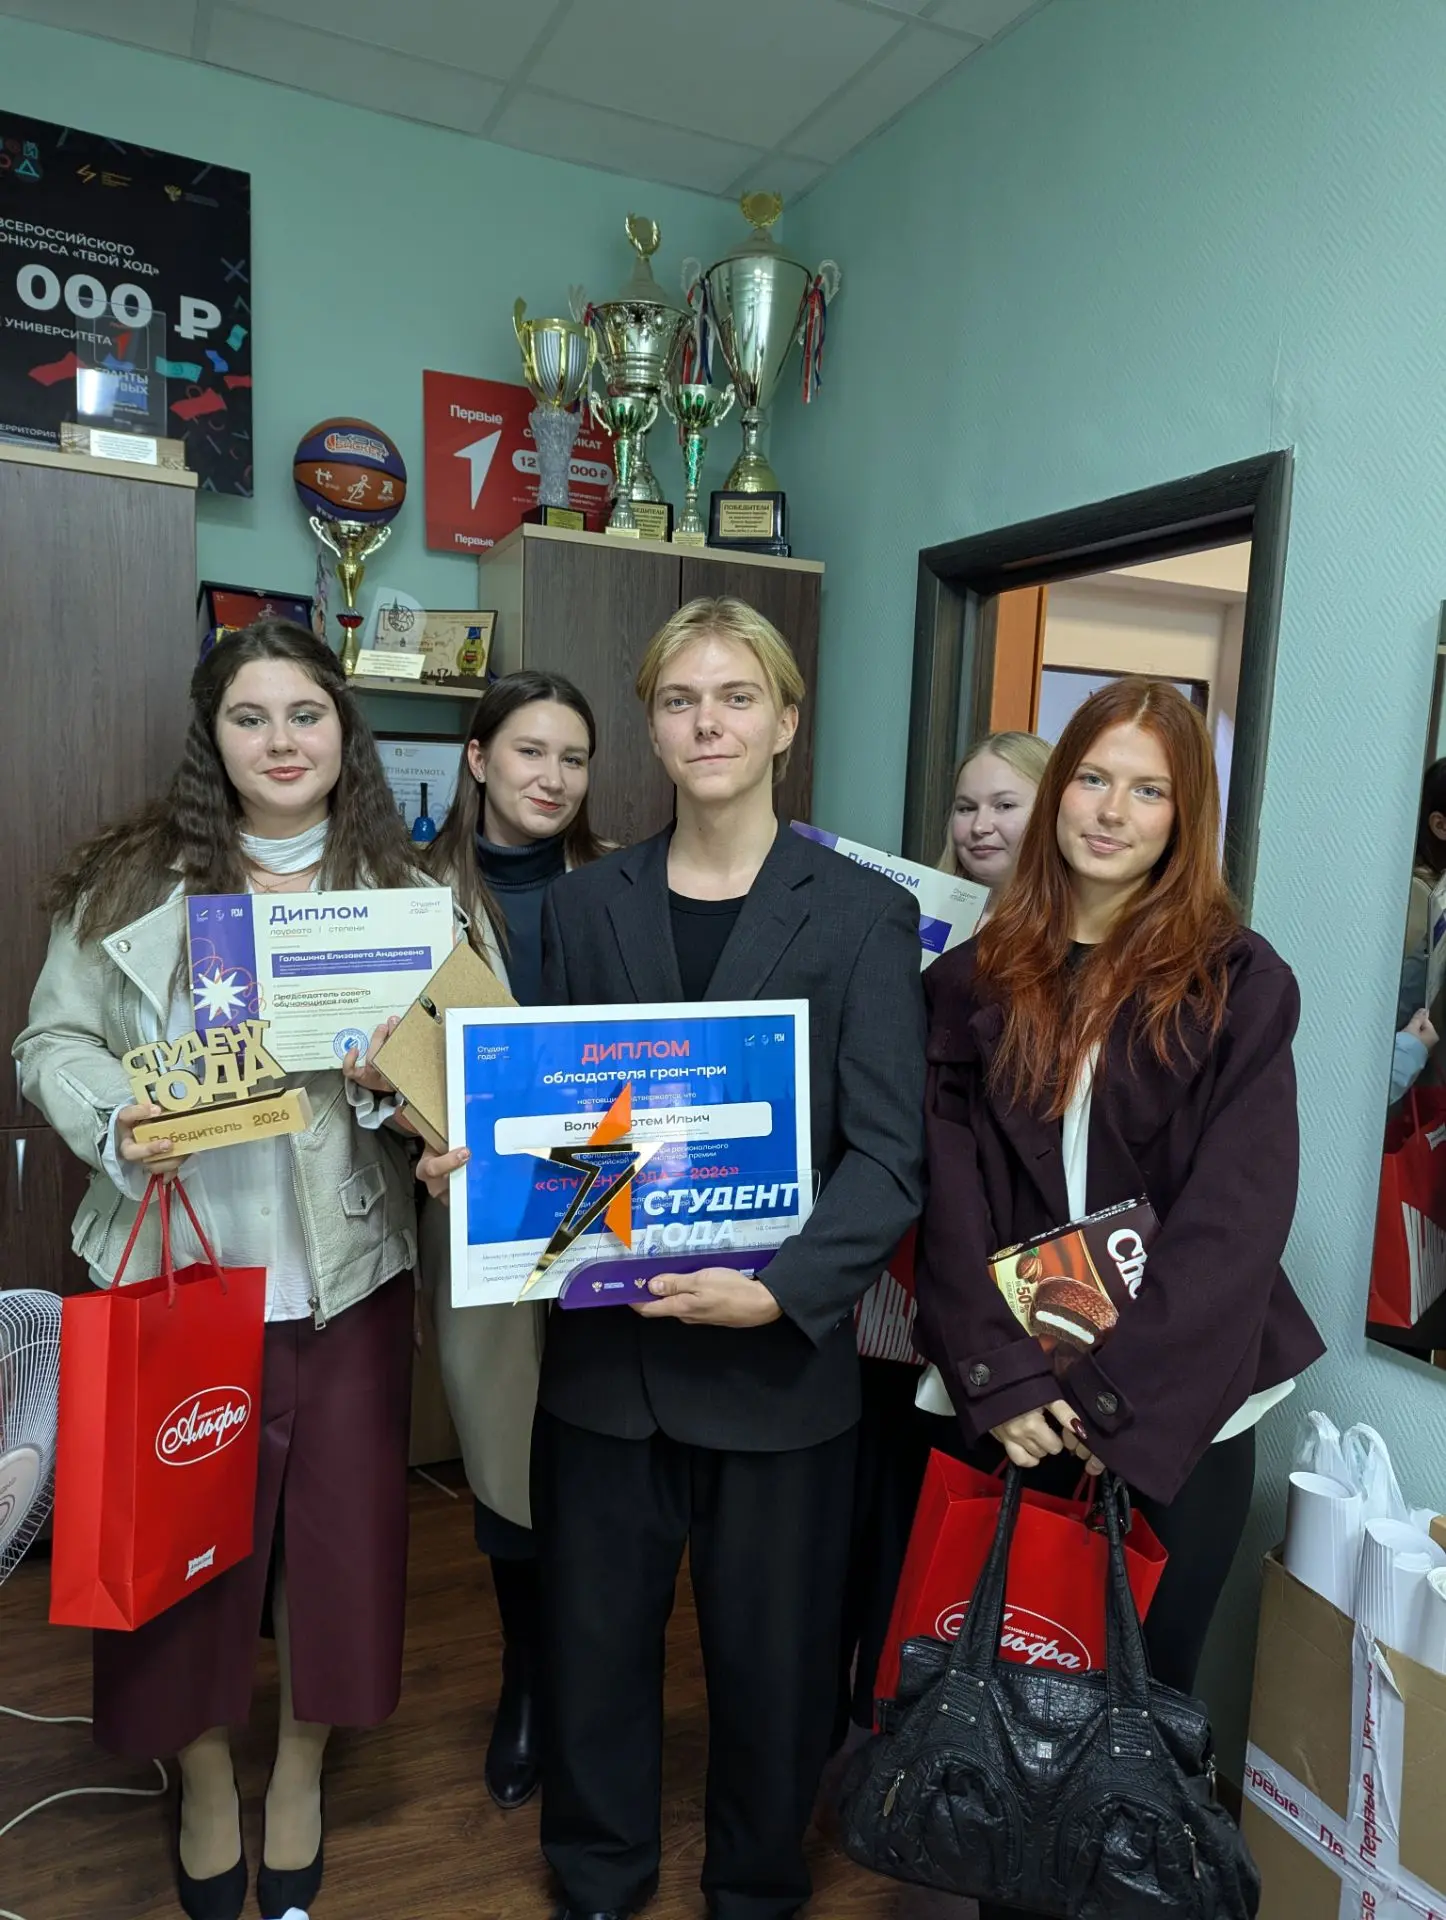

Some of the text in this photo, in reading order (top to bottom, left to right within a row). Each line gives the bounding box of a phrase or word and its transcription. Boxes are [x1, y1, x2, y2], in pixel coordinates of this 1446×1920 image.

[72, 248, 119, 268] «ТВОЙ
[122, 258, 160, 276] ХОД»
[16, 263, 153, 328] 000
[4, 316, 113, 346] УНИВЕРСИТЕТА
[450, 404, 503, 425] Первые
[454, 533, 495, 547] Первые
[269, 904, 369, 925] Диплом
[270, 928, 312, 937] лауреата
[327, 951, 374, 960] Елизавета
[375, 949, 425, 959] Андреевна
[273, 991, 339, 1001] Председатель
[122, 1019, 270, 1079] СТУДЕНТ
[581, 1039, 690, 1065] ДИПЛОМ
[129, 1052, 287, 1112] ГОДА
[543, 1064, 727, 1085] обладателя гран-при
[252, 1109, 290, 1126] 2026
[564, 1113, 710, 1132] Волк ртем Ильич
[643, 1183, 800, 1216] СТУДЕНТ
[644, 1219, 736, 1250] ГОДА
[162, 1400, 247, 1455] Альфа
[1244, 1763, 1299, 1818] ервые
[1360, 1773, 1382, 1869] Первые
